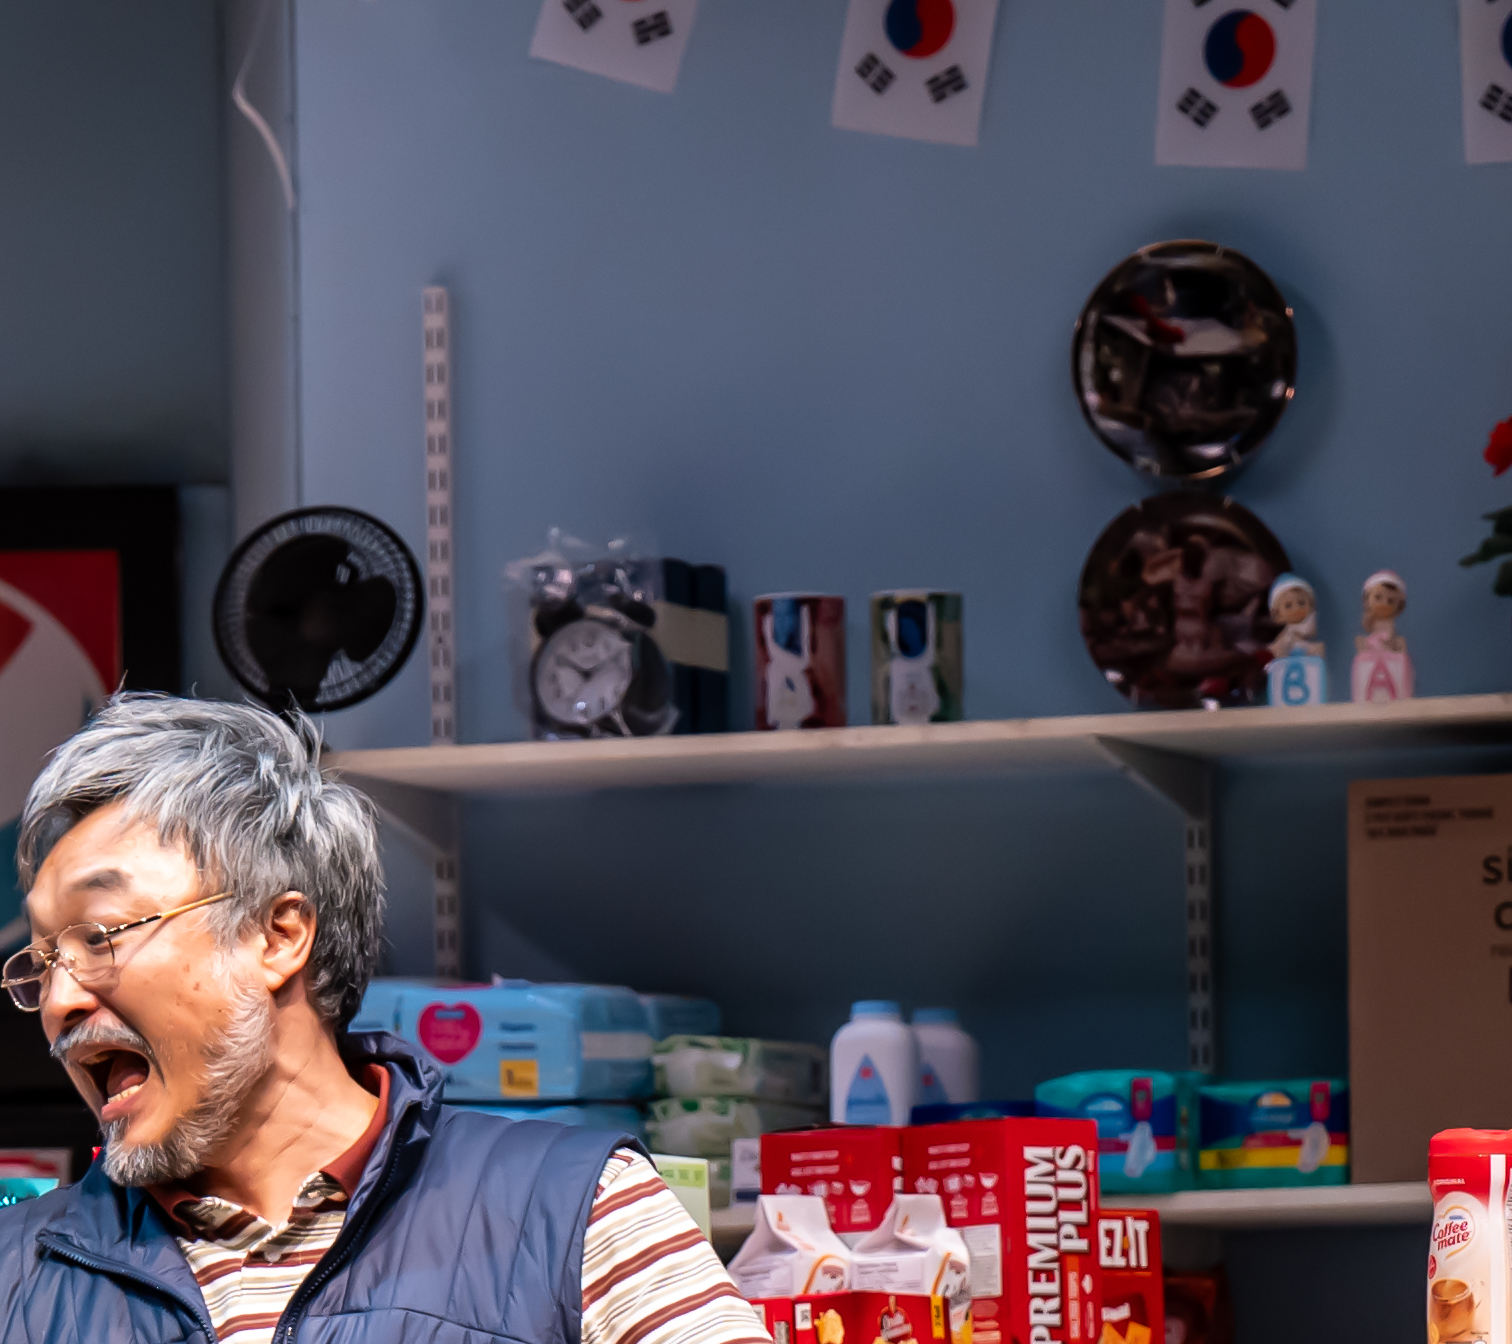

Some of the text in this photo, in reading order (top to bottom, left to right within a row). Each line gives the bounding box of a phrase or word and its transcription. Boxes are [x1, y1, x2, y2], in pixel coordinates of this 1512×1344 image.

[1057, 1143, 1090, 1254] PLUS
[1432, 1218, 1468, 1243] Coffee
[1437, 1230, 1470, 1251] mate
